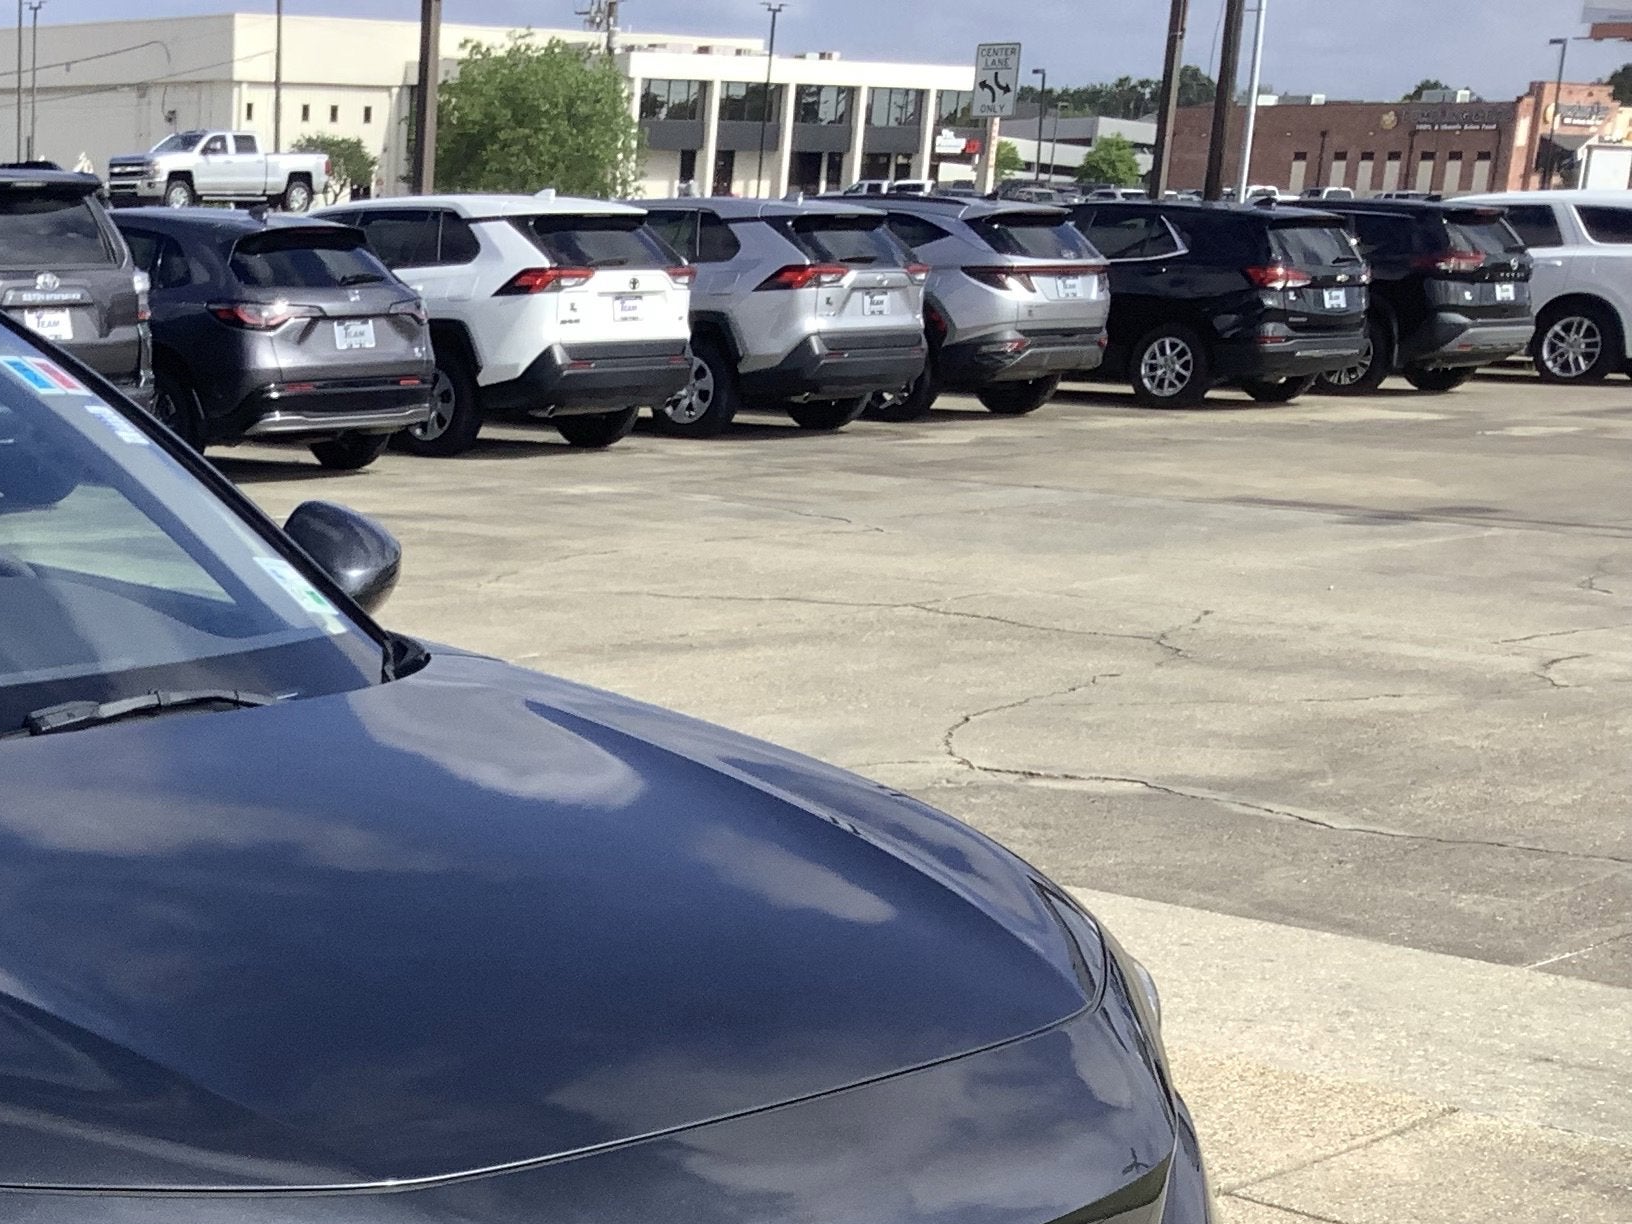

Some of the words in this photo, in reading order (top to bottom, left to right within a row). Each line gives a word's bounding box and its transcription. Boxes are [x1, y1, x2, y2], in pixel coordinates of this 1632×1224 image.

[980, 47, 1017, 58] CENTER
[985, 58, 1010, 67] LANE
[979, 104, 1005, 113] ONLY
